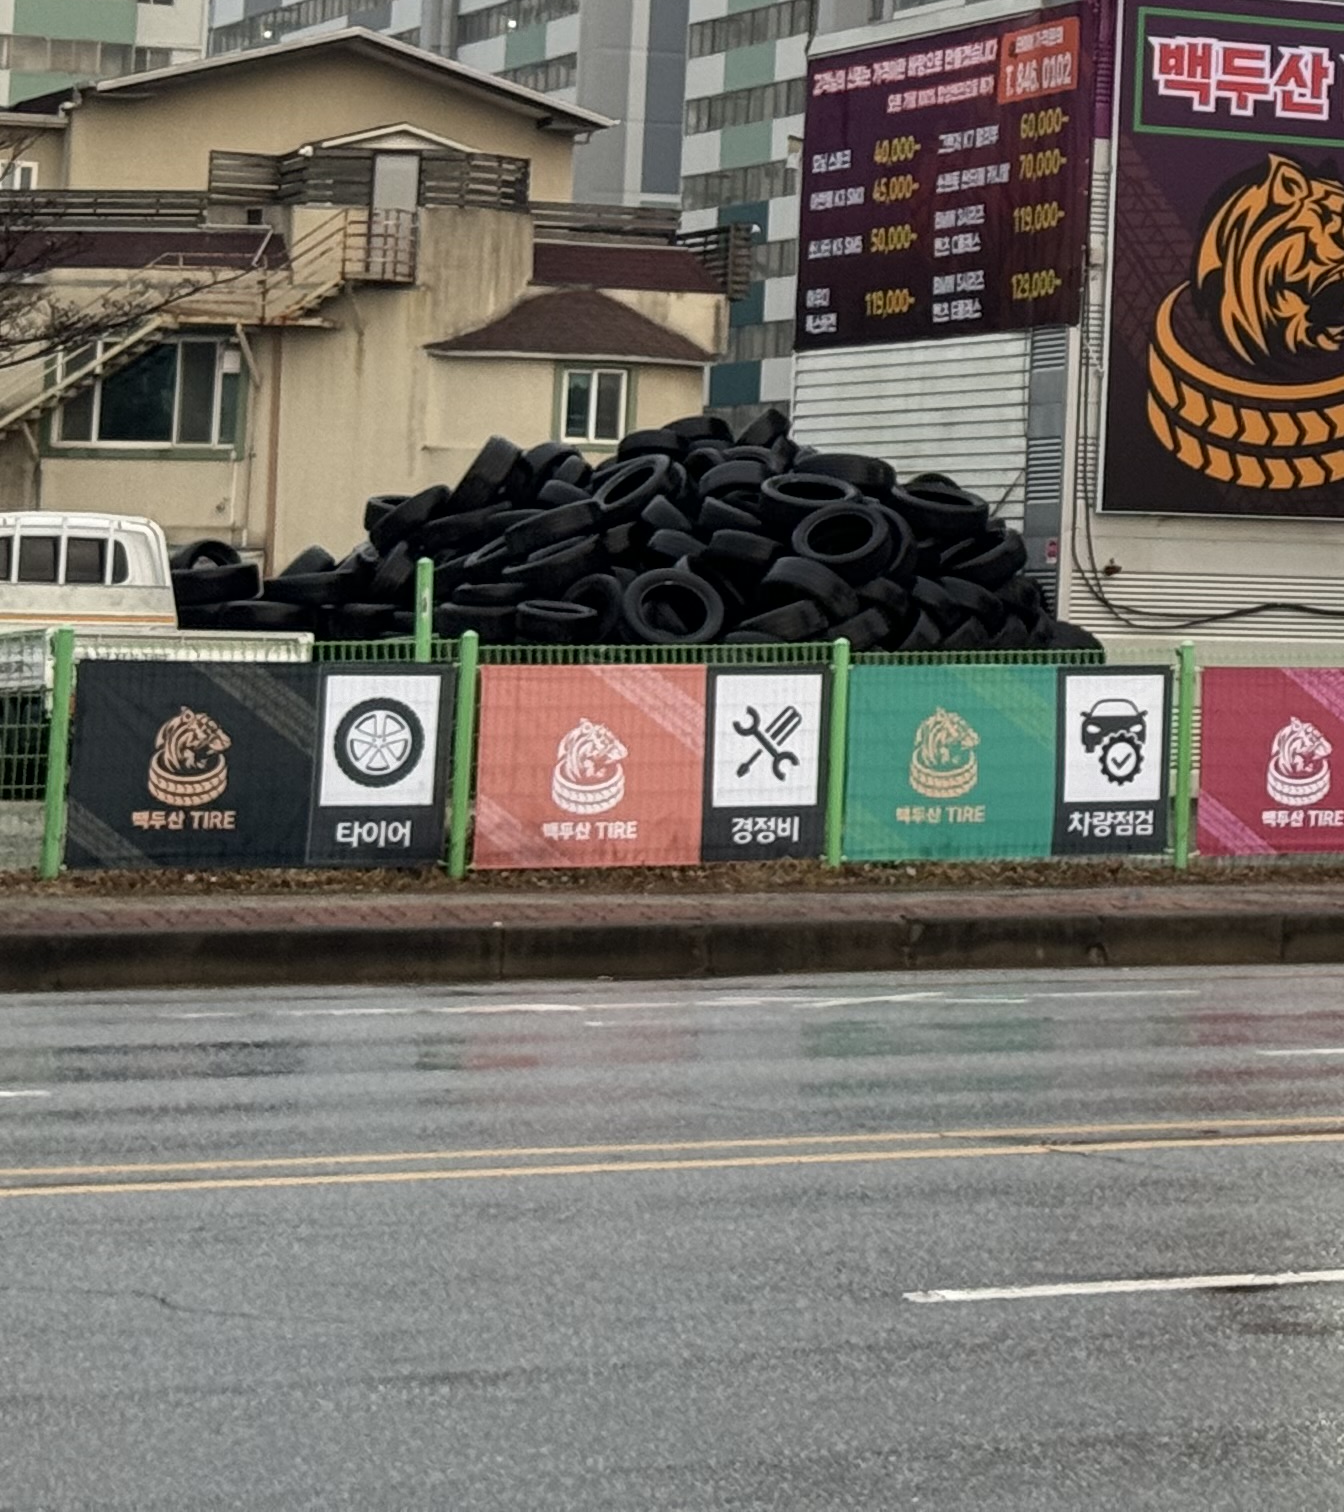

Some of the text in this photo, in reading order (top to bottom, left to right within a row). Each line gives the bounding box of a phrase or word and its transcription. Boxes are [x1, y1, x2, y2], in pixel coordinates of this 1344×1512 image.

[1148, 34, 1334, 121] 백두산
[131, 810, 238, 831] 백두산 TIRE
[895, 805, 986, 825] 백두산 TIRE
[1067, 809, 1154, 838] 차량점검
[1261, 810, 1305, 828] 백두산
[335, 819, 412, 849] 타이어
[542, 820, 638, 841] 백두산 TIRE
[731, 816, 800, 844] 경정비
